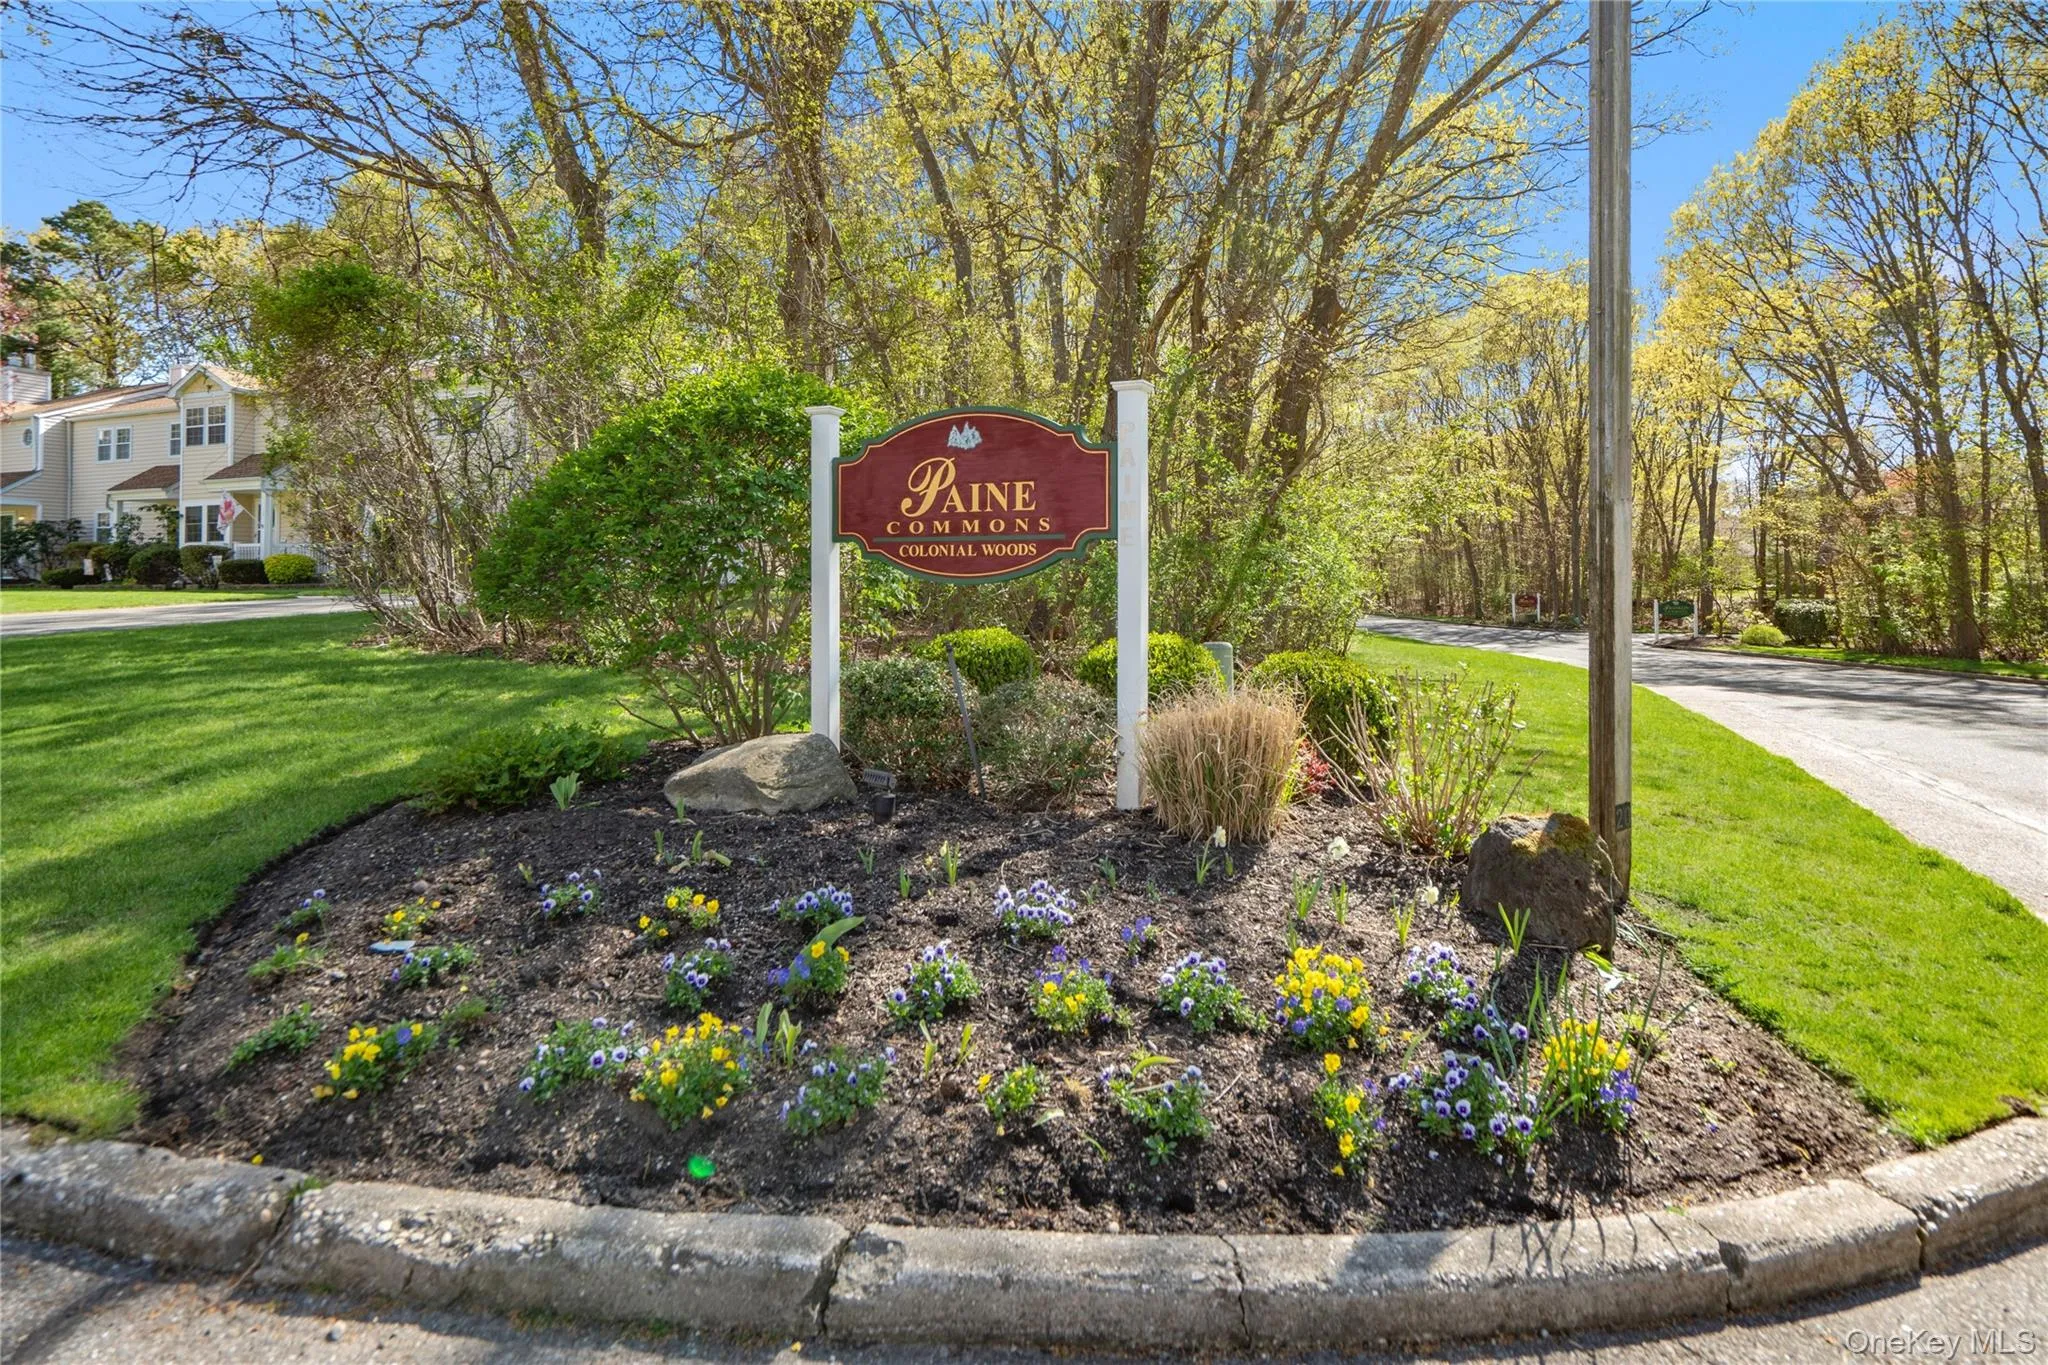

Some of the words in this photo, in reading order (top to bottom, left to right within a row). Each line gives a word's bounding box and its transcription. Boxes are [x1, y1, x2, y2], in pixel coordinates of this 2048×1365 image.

[901, 457, 1036, 517] PAINE
[886, 518, 1051, 535] COMMONS
[899, 544, 977, 558] COLONIAL
[981, 543, 1037, 556] WOODS
